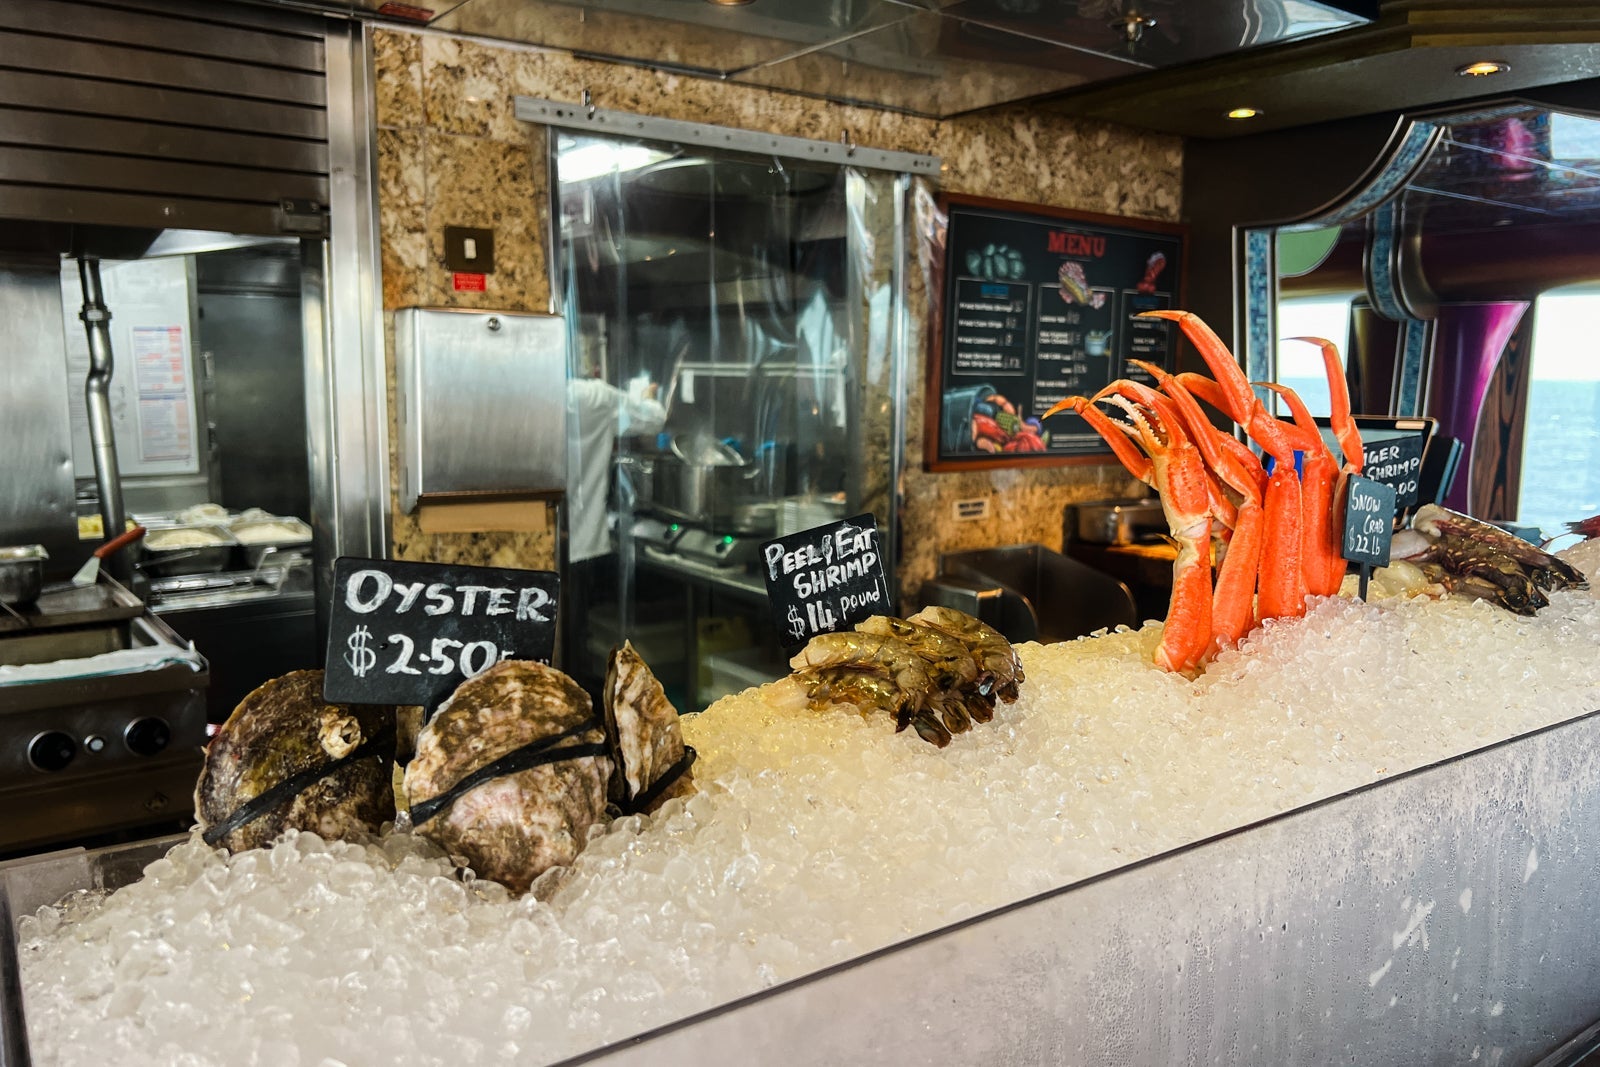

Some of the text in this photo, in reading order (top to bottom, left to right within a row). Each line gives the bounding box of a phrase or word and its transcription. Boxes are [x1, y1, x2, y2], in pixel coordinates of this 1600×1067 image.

[1047, 231, 1106, 258] MENU
[1363, 446, 1400, 467] IGER
[1366, 457, 1420, 481] SHRIMP
[1351, 482, 1381, 512] SNOW
[1386, 480, 1417, 495] .00
[1363, 514, 1384, 535] CRAB
[764, 543, 823, 581] PEEL
[835, 527, 876, 560] EAT
[793, 552, 877, 599] SHRIMP
[345, 569, 551, 622] OYSTER
[787, 600, 838, 640] $14
